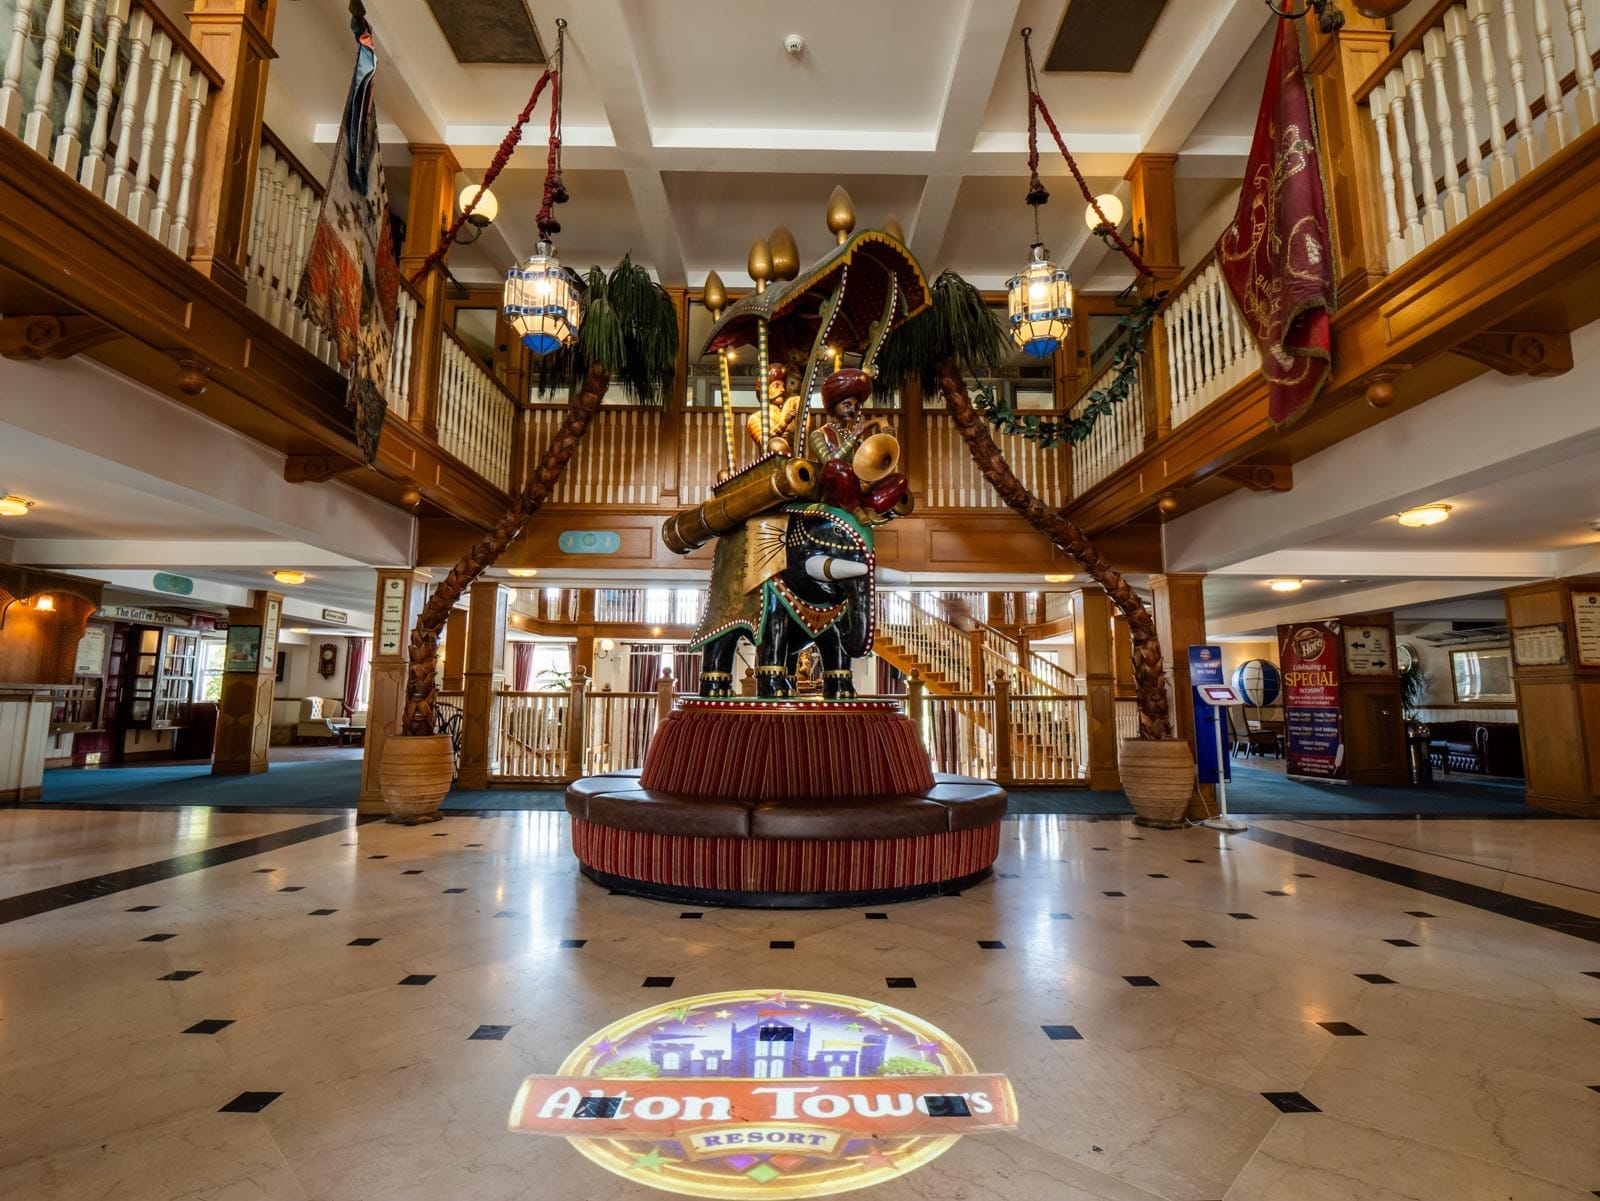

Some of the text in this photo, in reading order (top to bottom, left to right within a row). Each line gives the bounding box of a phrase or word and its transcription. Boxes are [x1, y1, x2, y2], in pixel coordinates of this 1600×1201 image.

[115, 607, 129, 617] The
[130, 609, 153, 620] Coffee
[1284, 671, 1338, 687] SPECIAL
[703, 1129, 827, 1148] RESORT
